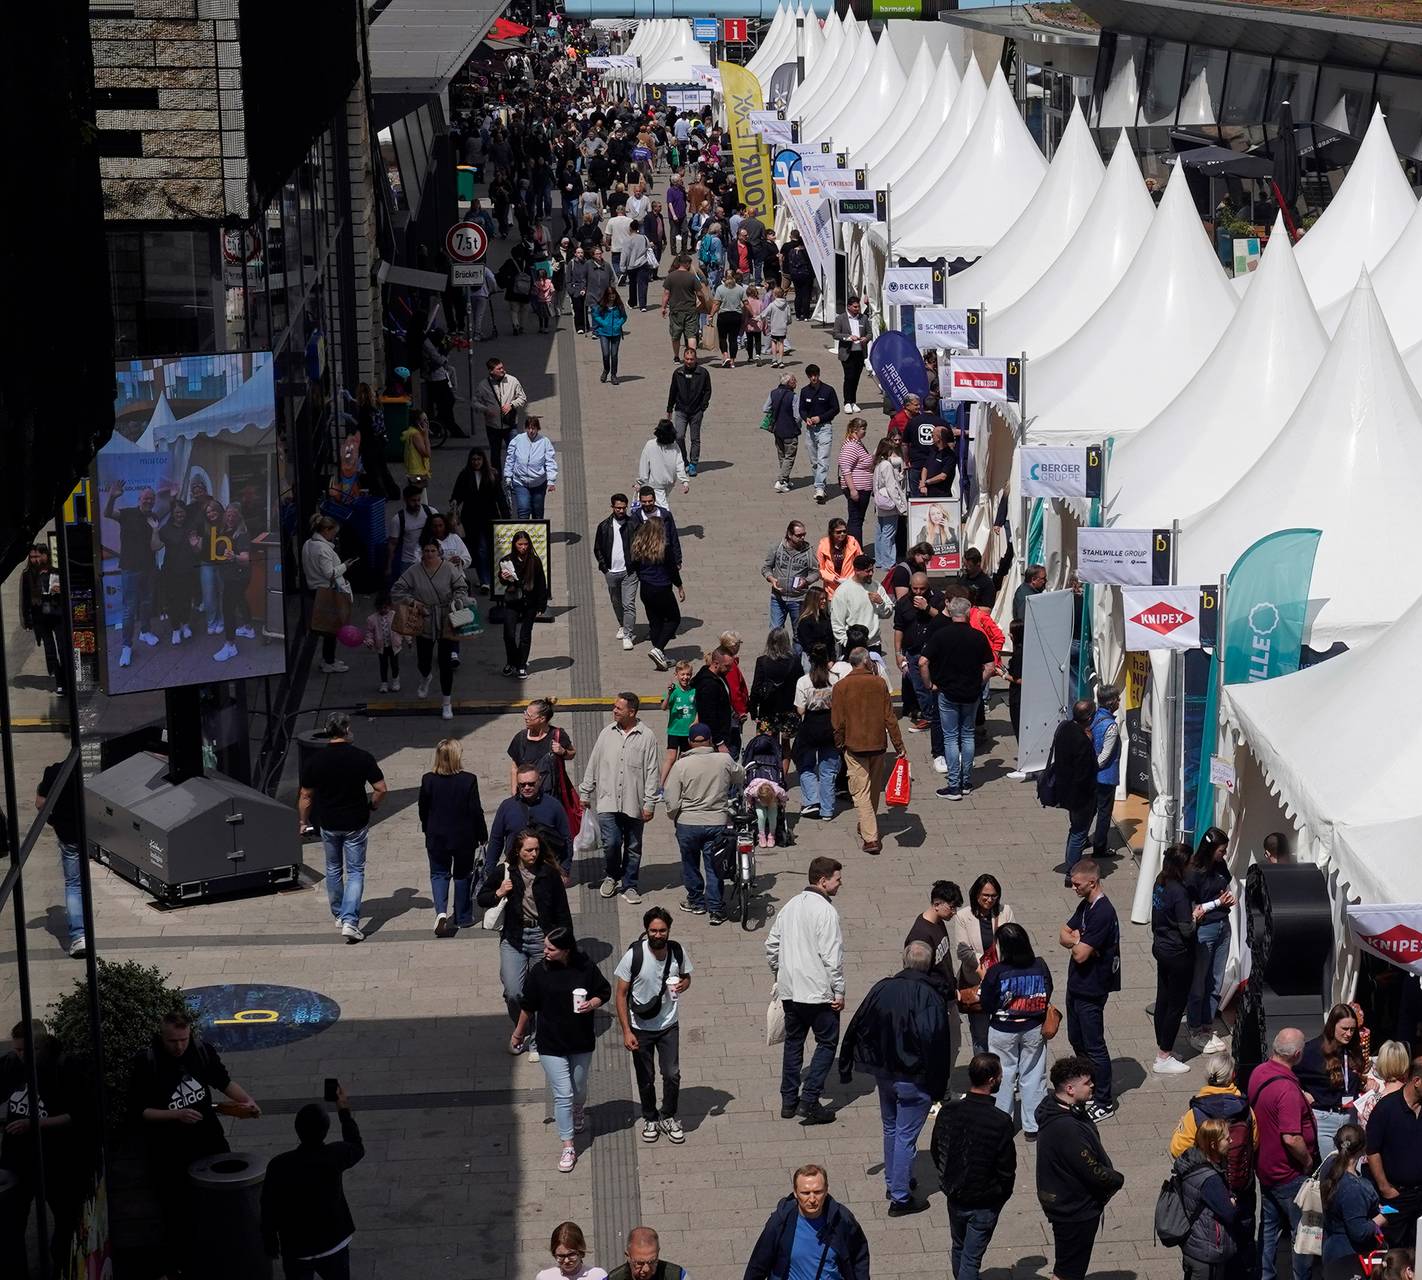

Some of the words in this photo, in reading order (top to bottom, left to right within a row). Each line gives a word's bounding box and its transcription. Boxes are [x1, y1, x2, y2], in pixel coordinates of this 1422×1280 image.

[844, 202, 870, 211] haupa
[474, 237, 478, 250] t
[899, 282, 930, 290] BECKER
[1089, 451, 1098, 466] b
[1041, 464, 1080, 472] BERGER
[1041, 472, 1080, 482] GRUPPE
[1156, 534, 1167, 552] b
[1082, 548, 1123, 557] STAHLWILLE
[1124, 550, 1148, 558] GROUP
[1202, 592, 1214, 609] b
[1140, 613, 1184, 625] KNIPEX
[894, 765, 904, 797] akzenta
